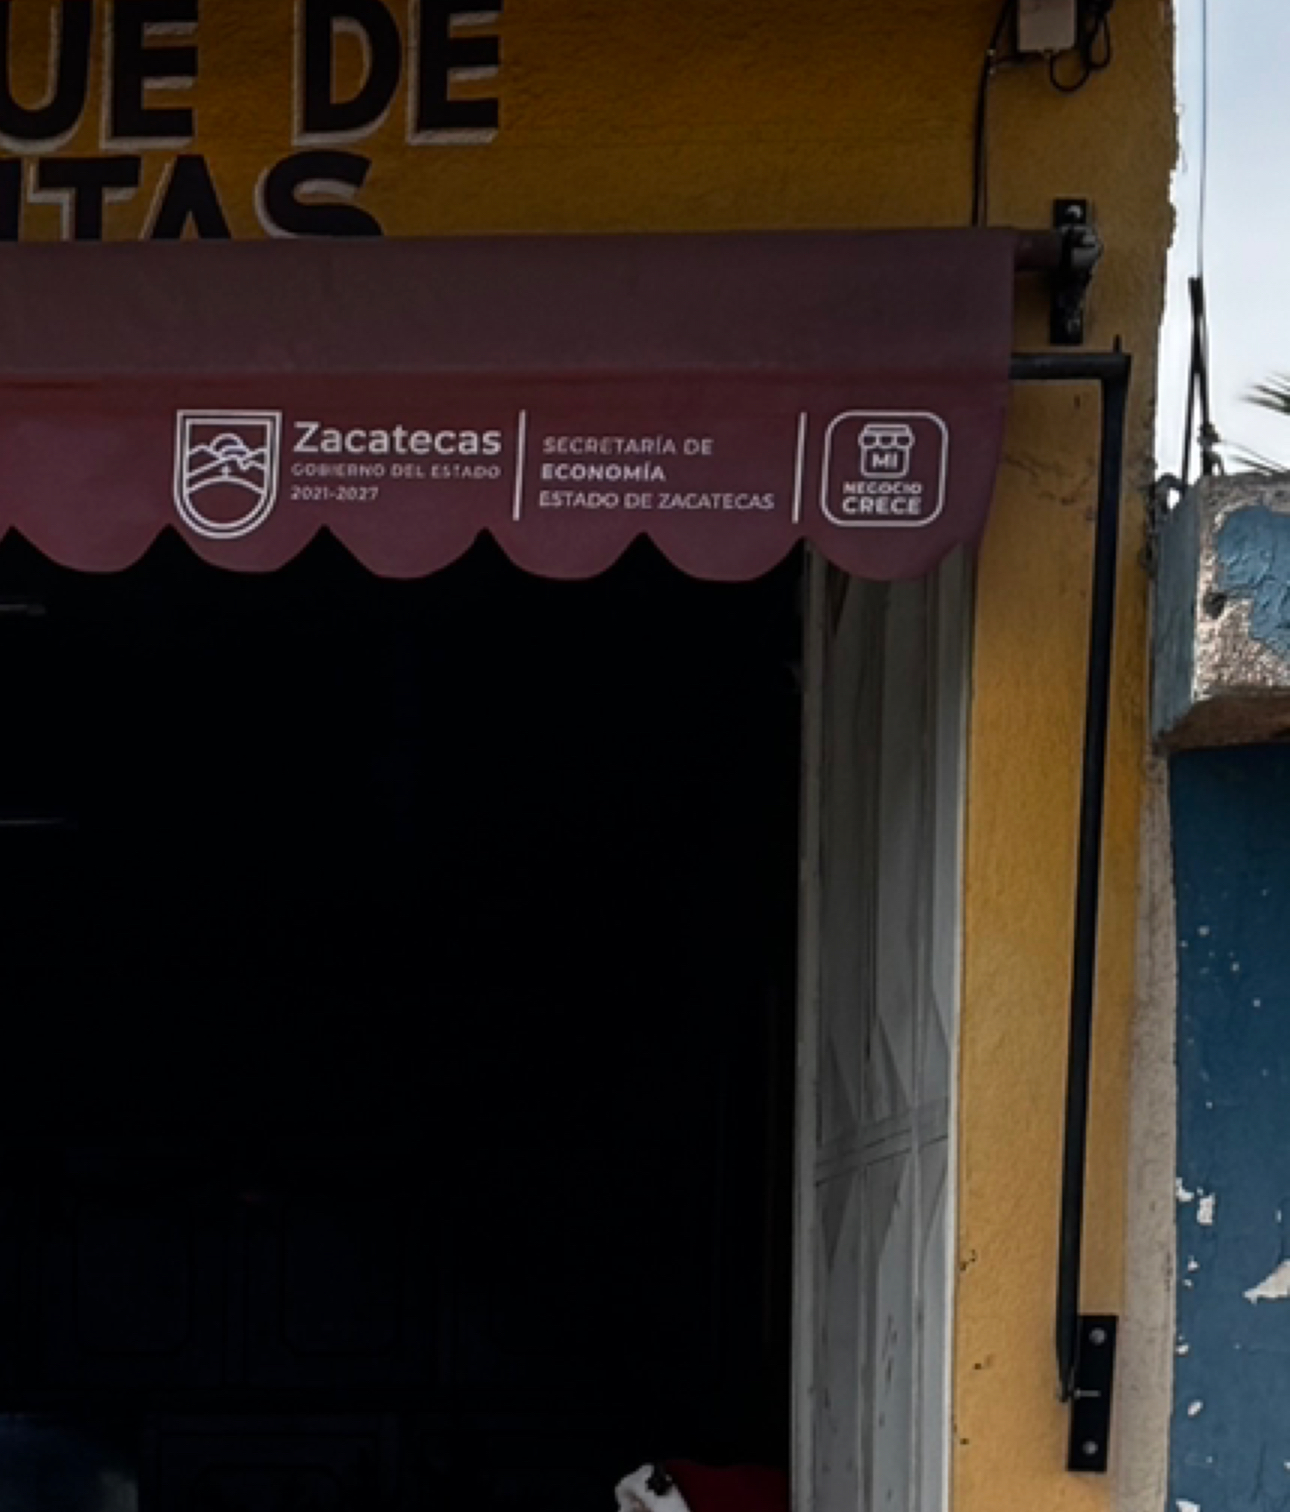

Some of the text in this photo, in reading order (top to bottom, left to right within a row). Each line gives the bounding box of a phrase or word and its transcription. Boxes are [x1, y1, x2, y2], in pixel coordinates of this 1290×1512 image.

[293, 420, 502, 456] Zacatecas
[542, 434, 715, 457] SECRETARÍA DE
[872, 451, 898, 470] MI
[290, 462, 502, 480] GOBIERNO DEL ESTADO
[541, 460, 666, 482] ECONOMÍA
[290, 485, 379, 501] 2021-2027
[842, 480, 923, 495] NEGOCIO
[539, 490, 775, 511] ESTADO DE ZACATECAS
[841, 496, 922, 515] CRECE
